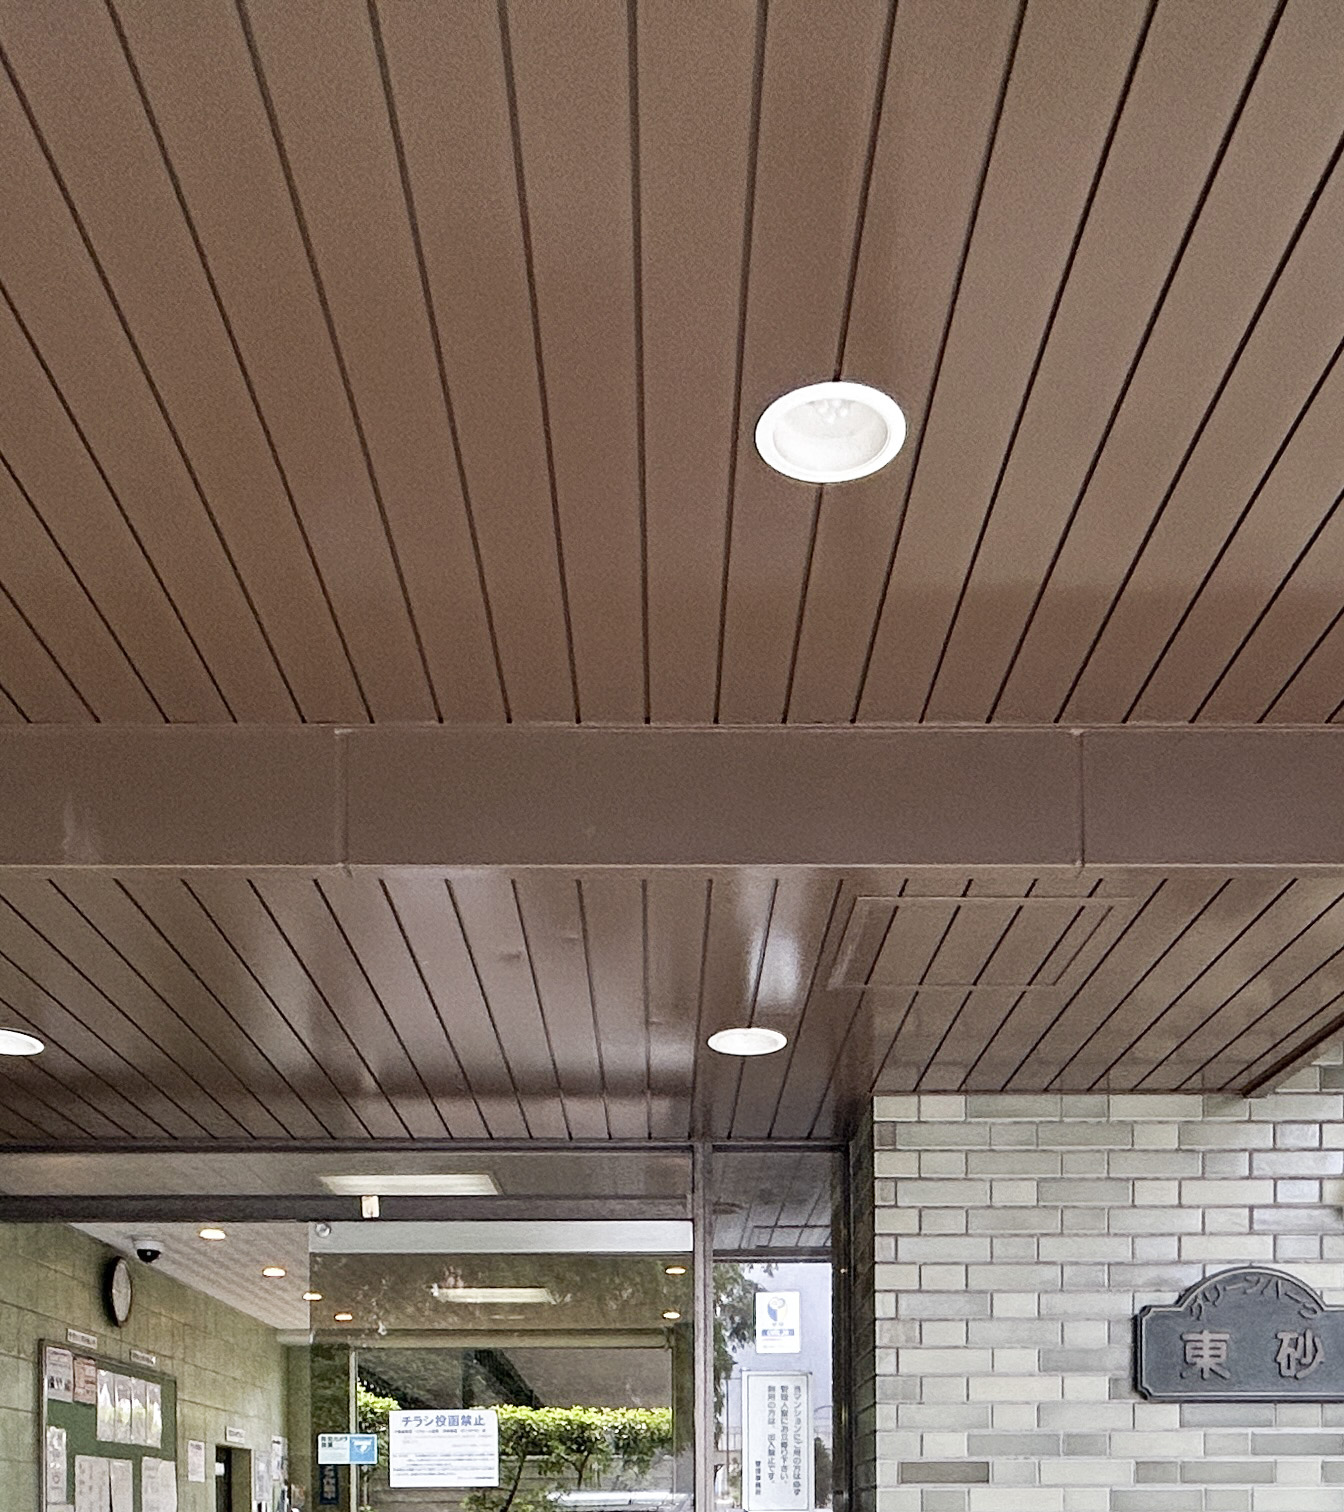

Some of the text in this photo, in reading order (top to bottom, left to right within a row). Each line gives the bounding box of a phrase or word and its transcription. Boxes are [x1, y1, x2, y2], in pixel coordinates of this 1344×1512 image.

[1180, 1328, 1325, 1381] 東砂
[401, 1414, 486, 1427] チラシ投函禁止
